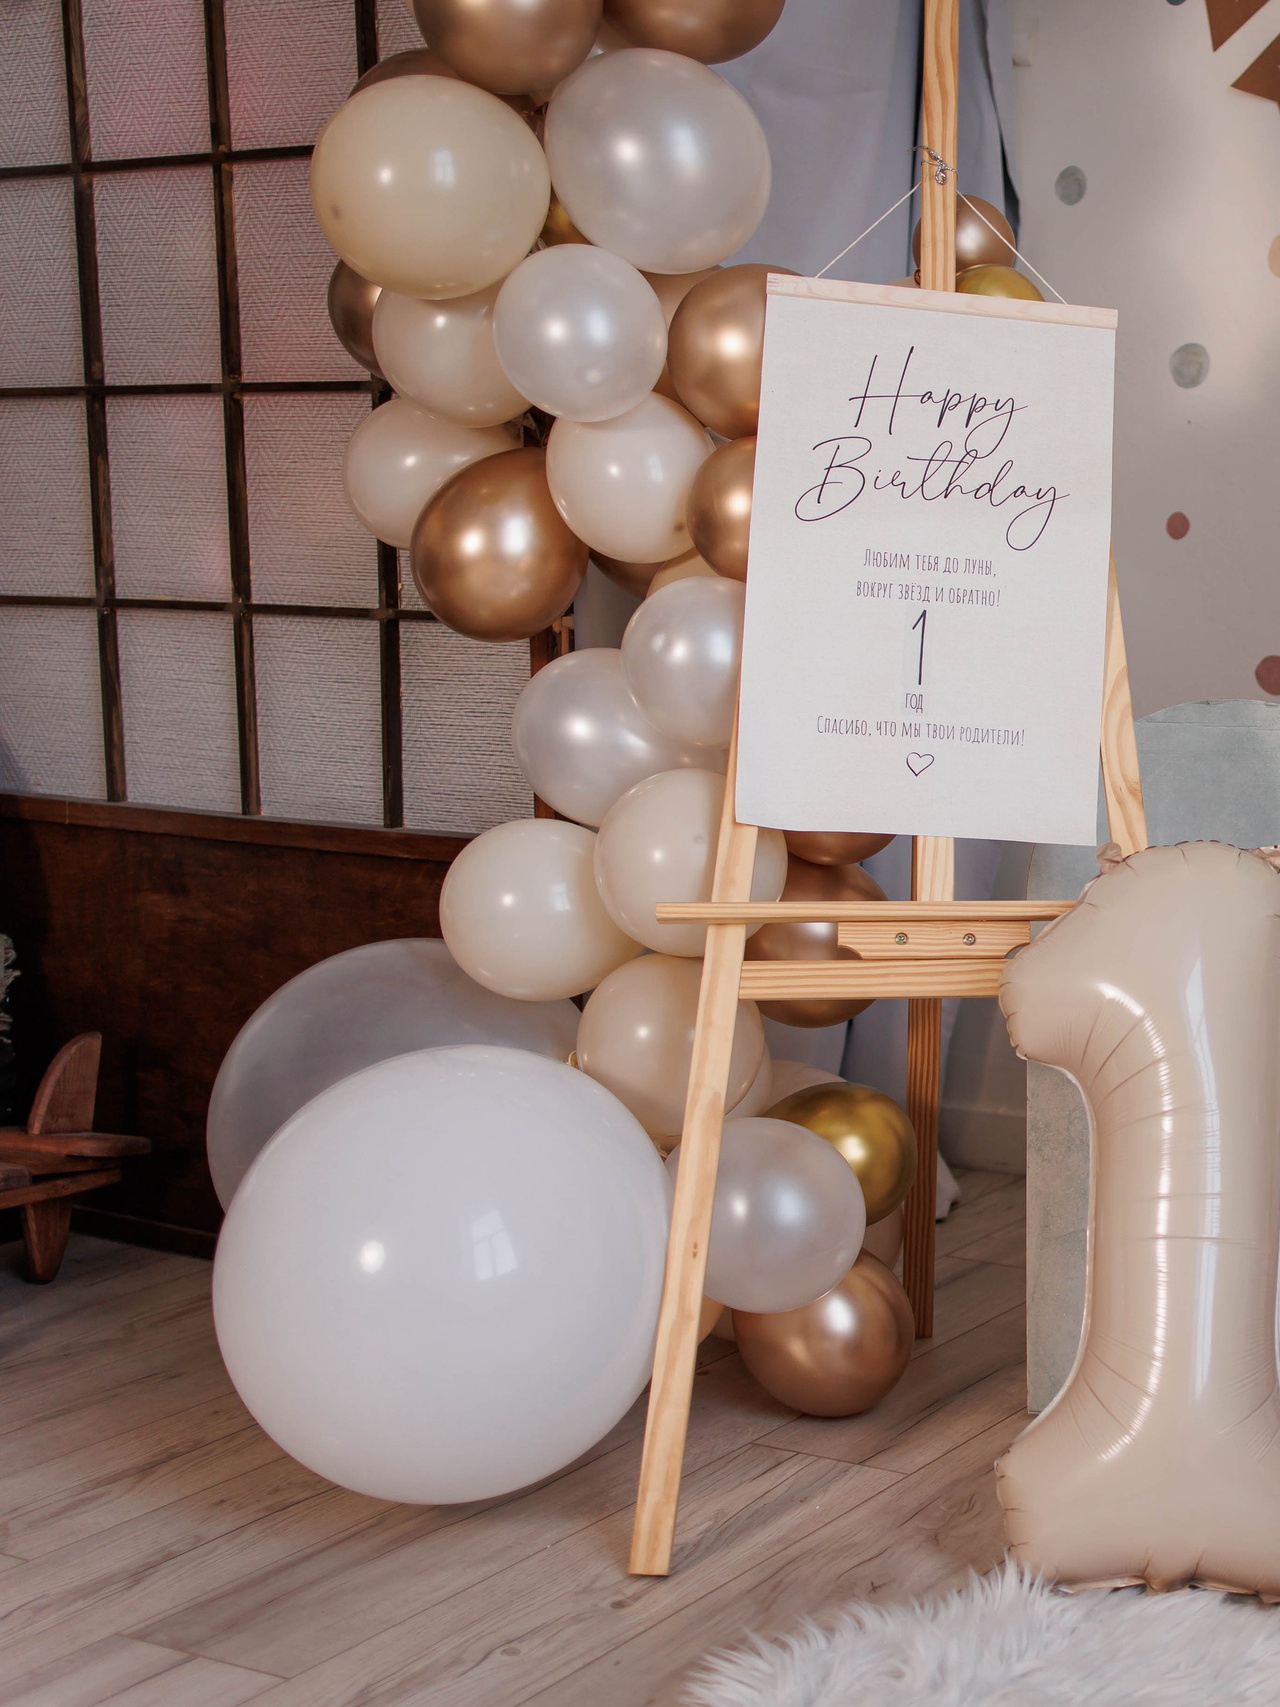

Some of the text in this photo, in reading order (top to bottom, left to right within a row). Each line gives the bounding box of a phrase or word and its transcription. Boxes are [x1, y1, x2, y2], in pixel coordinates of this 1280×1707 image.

[848, 345, 1028, 459] Happy
[794, 435, 1071, 551] Birthday
[911, 608, 927, 686] 1
